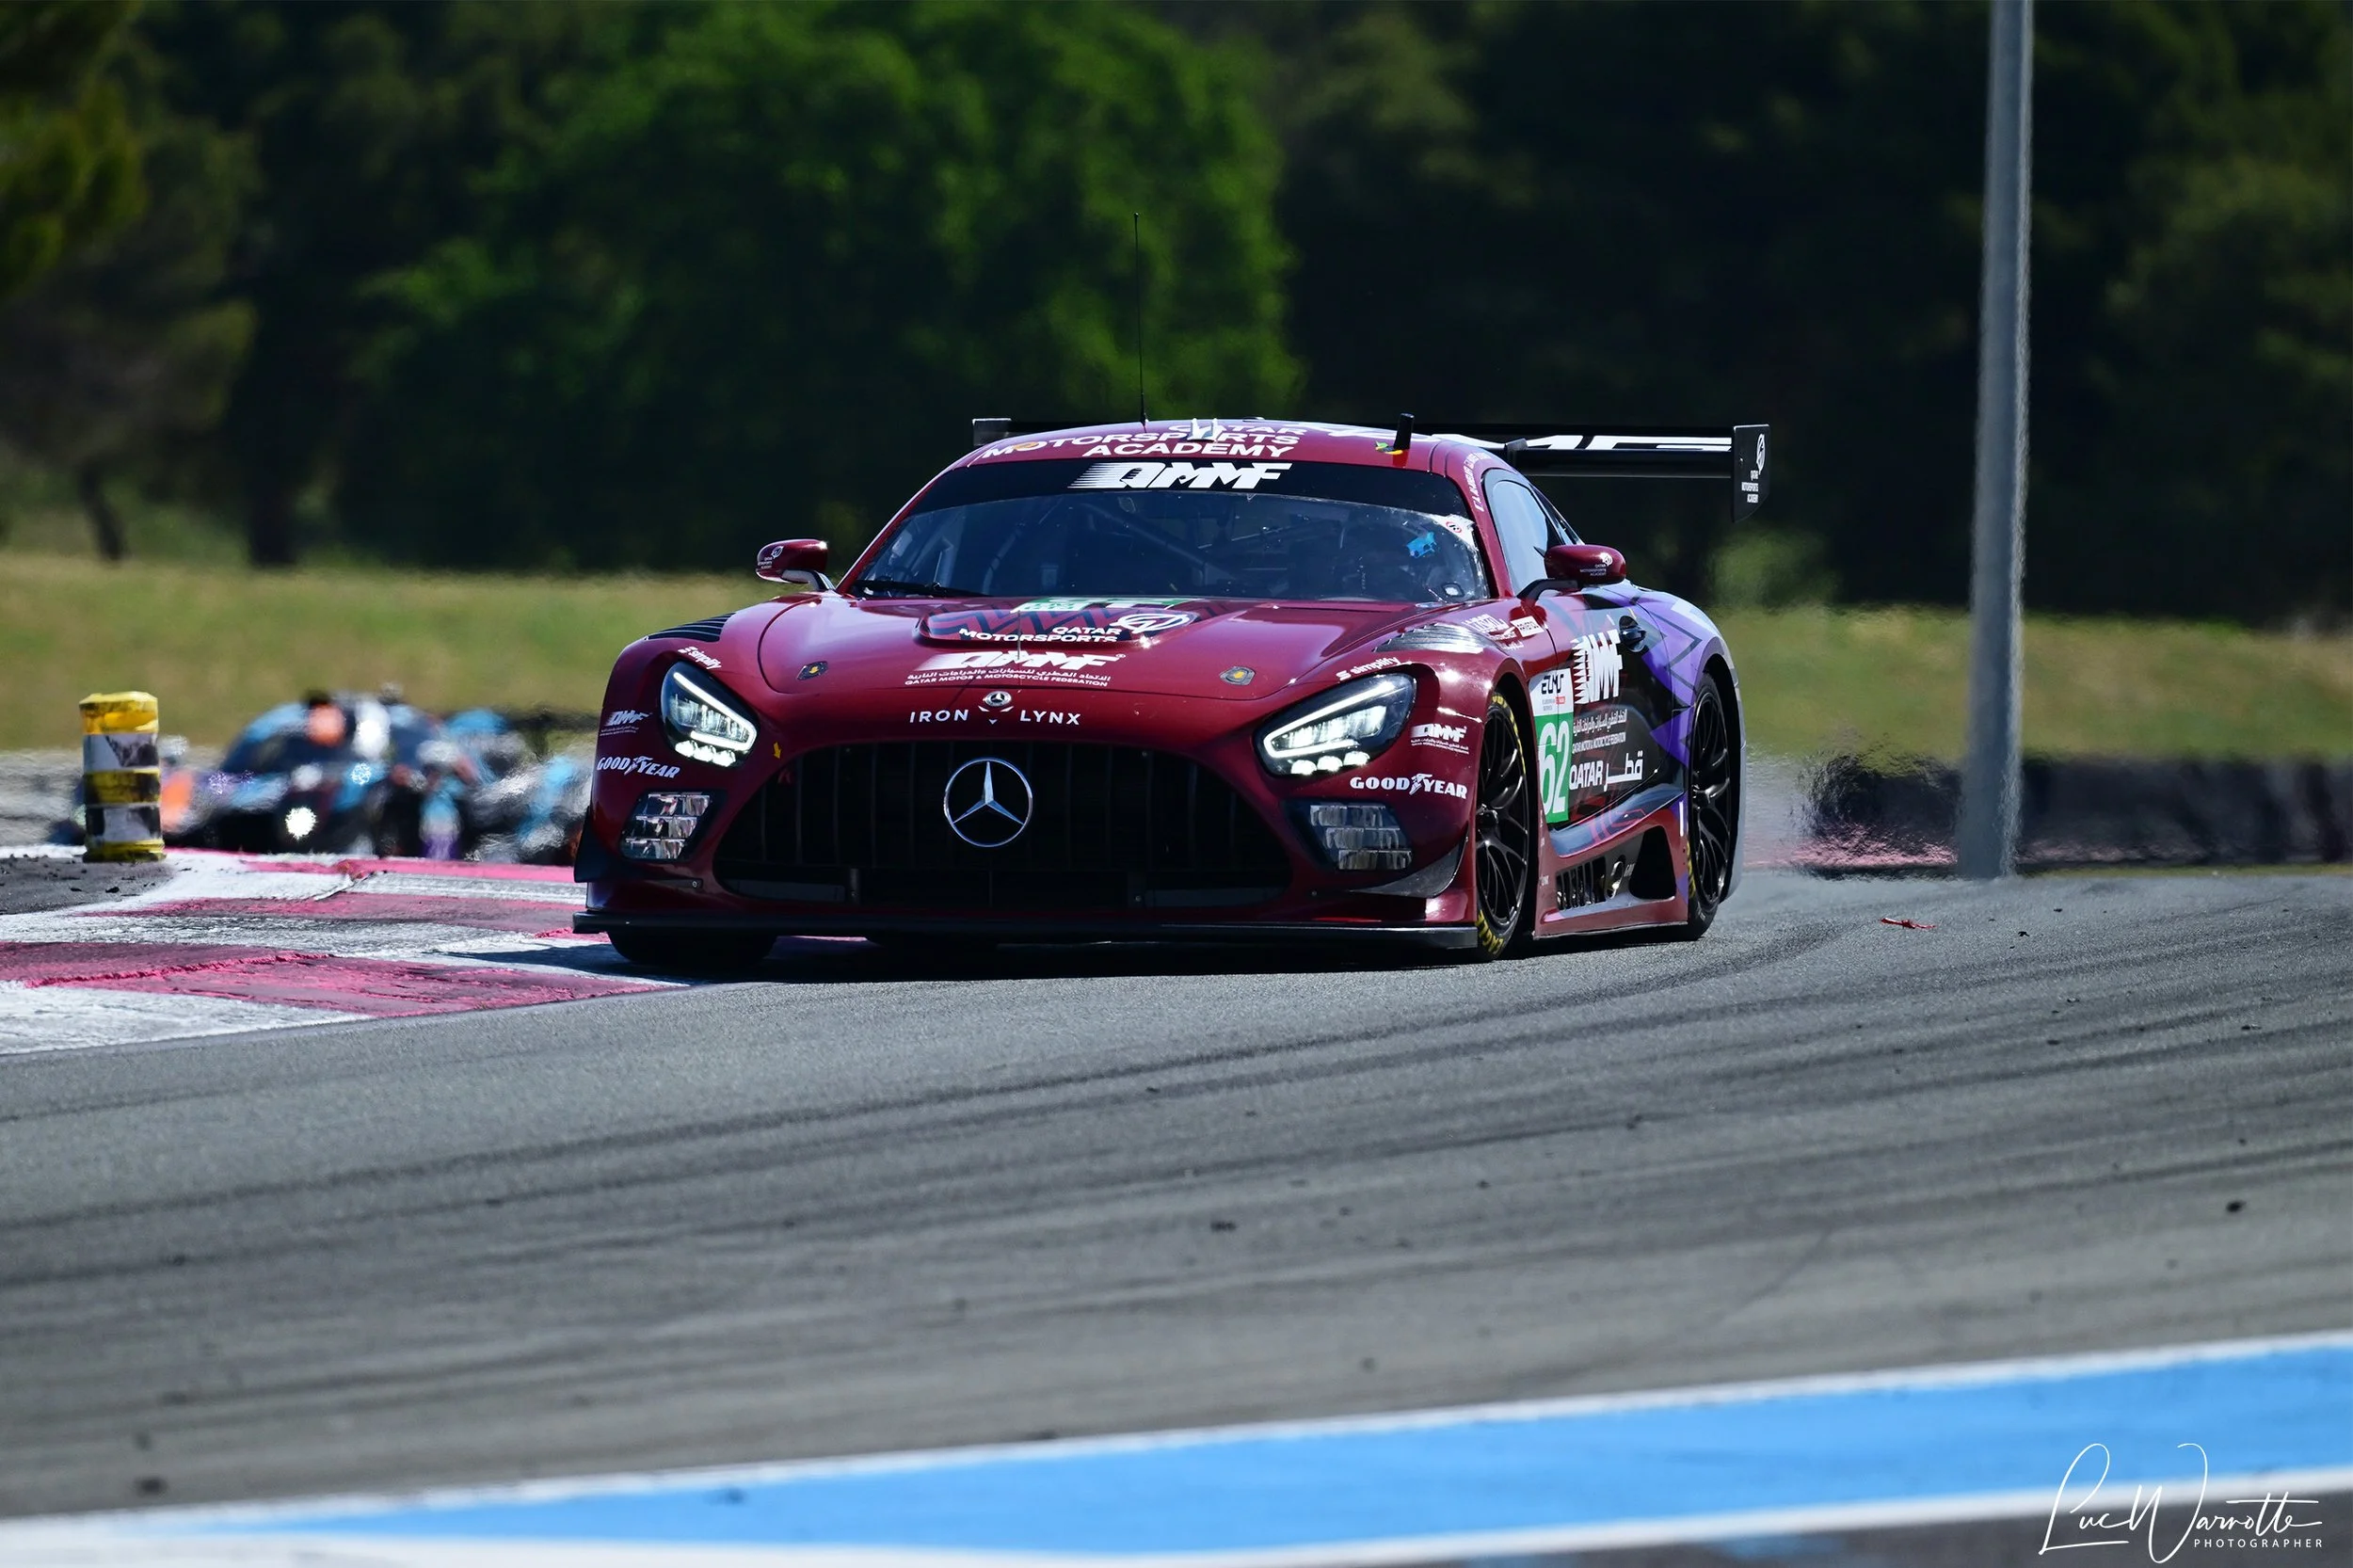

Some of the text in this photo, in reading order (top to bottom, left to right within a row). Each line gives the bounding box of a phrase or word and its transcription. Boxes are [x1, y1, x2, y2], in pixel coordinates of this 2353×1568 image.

[982, 431, 1301, 459] MOTORSPRTS
[1081, 442, 1295, 458] ACADEMY
[958, 628, 1118, 643] MOTORSPORTS
[1052, 626, 1122, 635] QATAR
[1350, 657, 1401, 675] simplify
[904, 678, 937, 686] QATAR
[984, 673, 1049, 681] MOTORCYCLE
[1050, 676, 1109, 687] FEDERATION
[909, 709, 1081, 726] IRON LYNX
[1539, 720, 1570, 816] 62
[1569, 760, 1603, 790] QATAR
[1603, 750, 1643, 792] قطر
[1350, 773, 1468, 799] GOODYEAR
